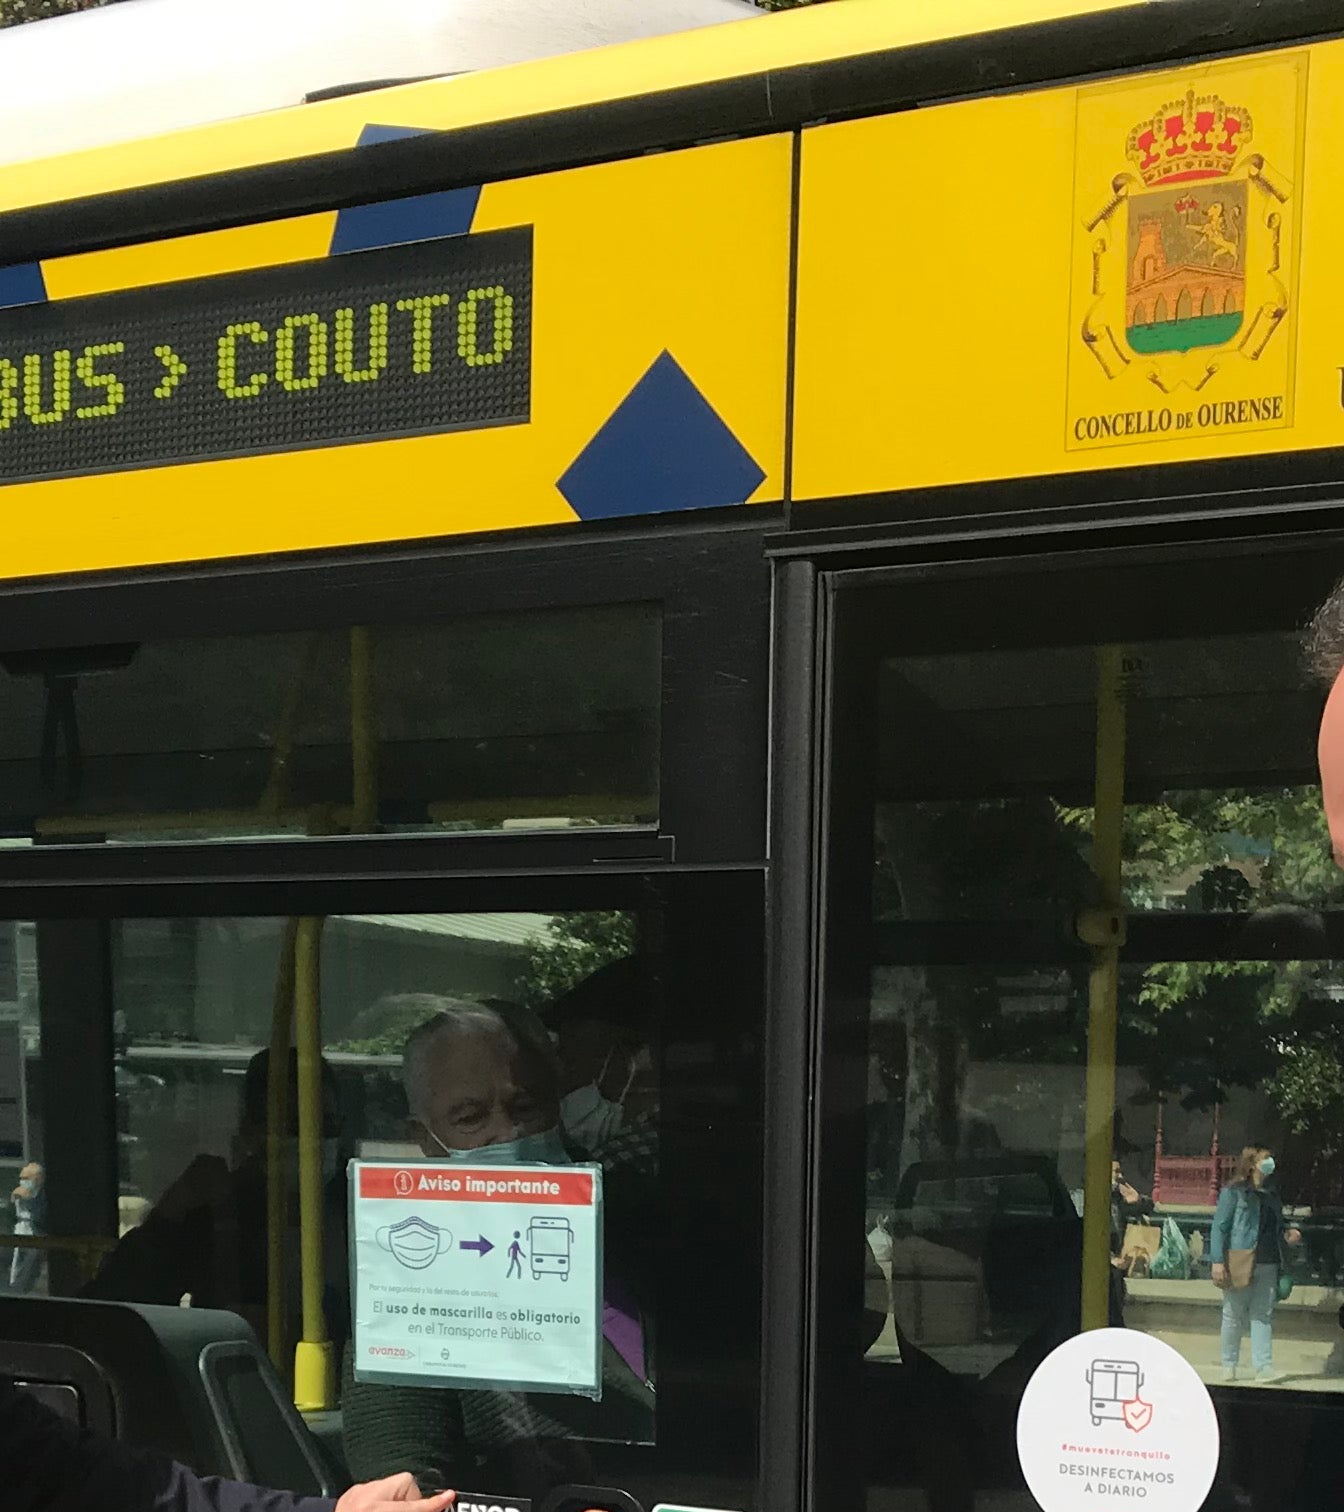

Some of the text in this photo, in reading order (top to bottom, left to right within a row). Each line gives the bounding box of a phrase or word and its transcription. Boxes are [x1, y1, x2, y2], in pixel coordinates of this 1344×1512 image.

[217, 284, 513, 399] COUTO
[1075, 408, 1172, 441] CONCELLO
[1197, 396, 1284, 428] OURENSE
[418, 1173, 461, 1191] Aviso
[466, 1175, 560, 1196] importante
[373, 1301, 581, 1325] El uso de mascarilla es obligatorio
[408, 1322, 544, 1342] en el Transporte Público.
[368, 1346, 405, 1357] avanza
[1062, 1443, 1170, 1460] #muevetetranquilo
[1059, 1463, 1174, 1484] DESINFECTAMOS
[1084, 1482, 1147, 1498] A DIARIO
